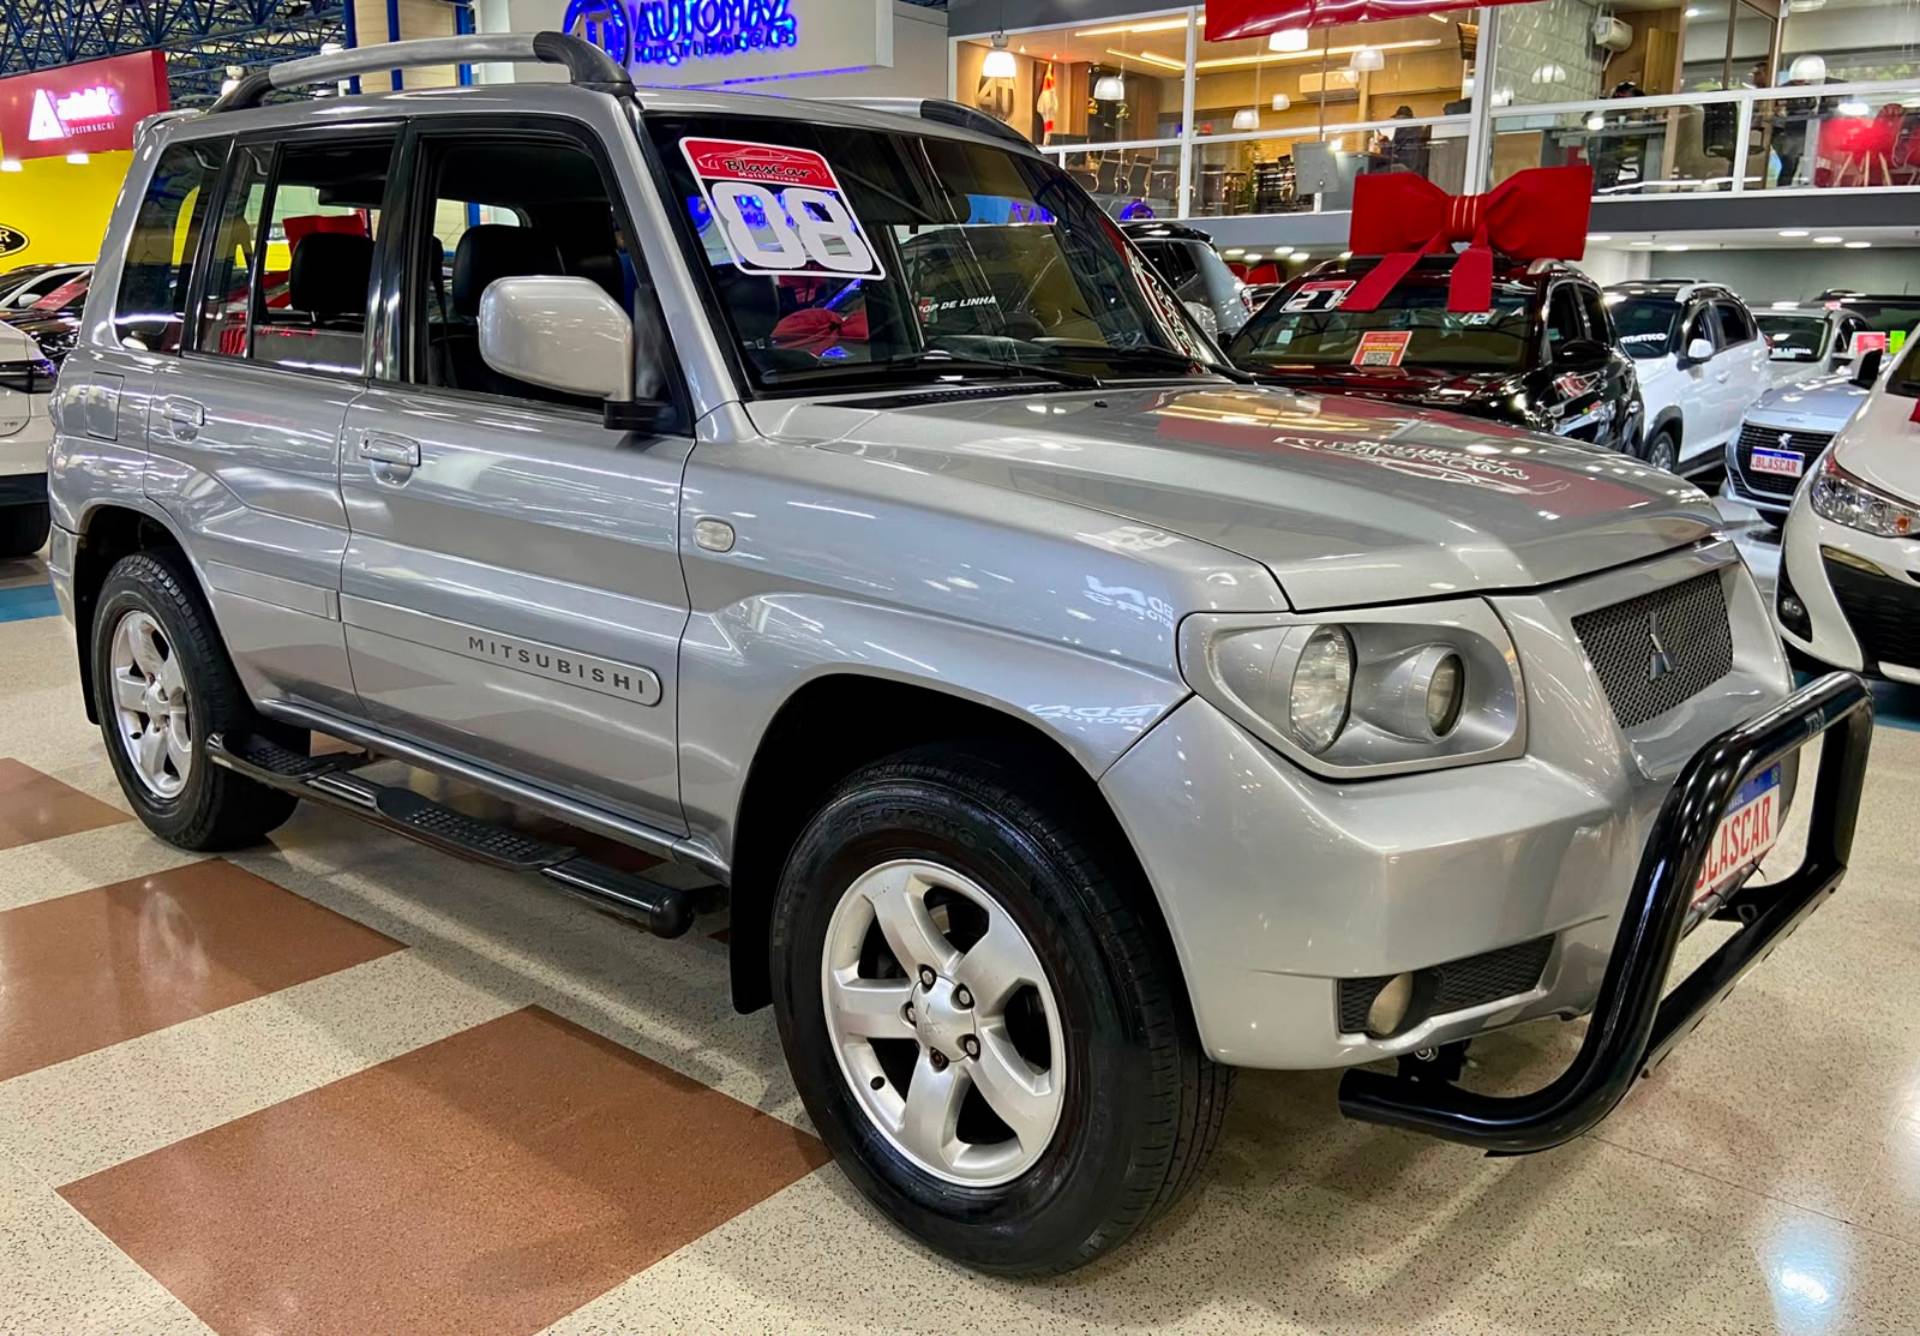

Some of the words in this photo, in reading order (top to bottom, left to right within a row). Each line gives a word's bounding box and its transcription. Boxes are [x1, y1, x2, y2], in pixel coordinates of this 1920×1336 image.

[711, 182, 873, 272] 08
[941, 300, 958, 310] DE
[960, 294, 996, 307] LINHA
[1285, 290, 1344, 310] 21
[468, 636, 644, 694] MITSUBISHI
